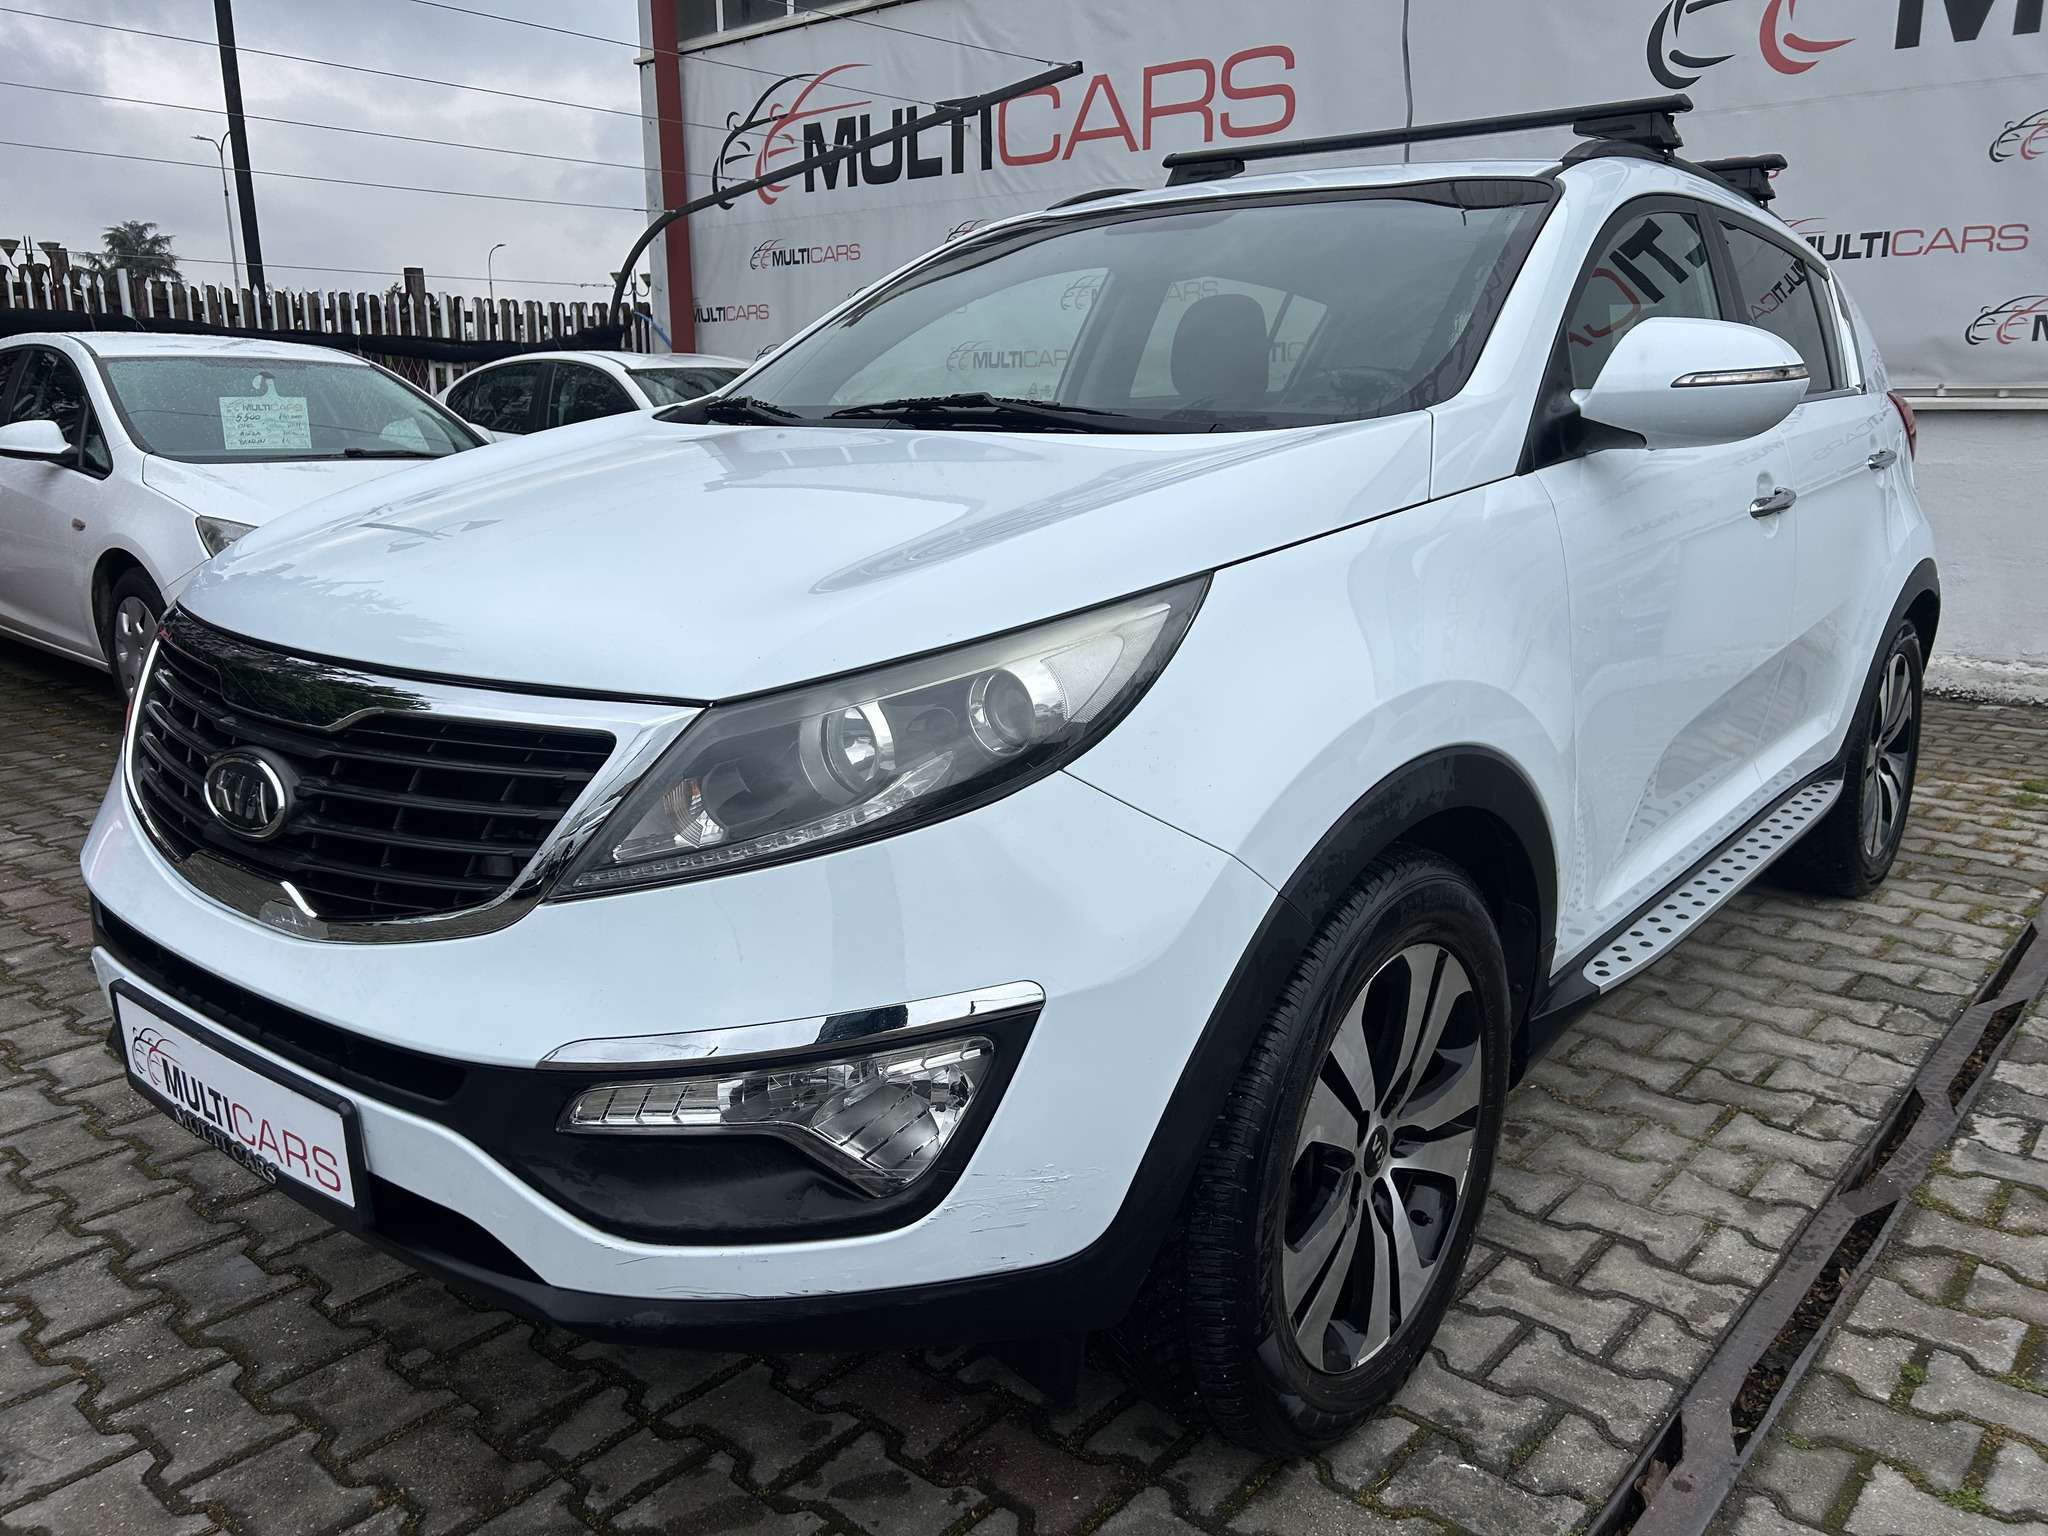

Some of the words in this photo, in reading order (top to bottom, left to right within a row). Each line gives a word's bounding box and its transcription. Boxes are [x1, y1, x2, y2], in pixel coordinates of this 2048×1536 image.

[803, 44, 1296, 193] MULTICARS
[772, 243, 861, 267] MULTICARS
[1805, 223, 2030, 261] ULTICARS
[972, 349, 1070, 369] MULTICAR
[161, 1057, 341, 1192] MULTICARS
[230, 1140, 281, 1184] CARS
